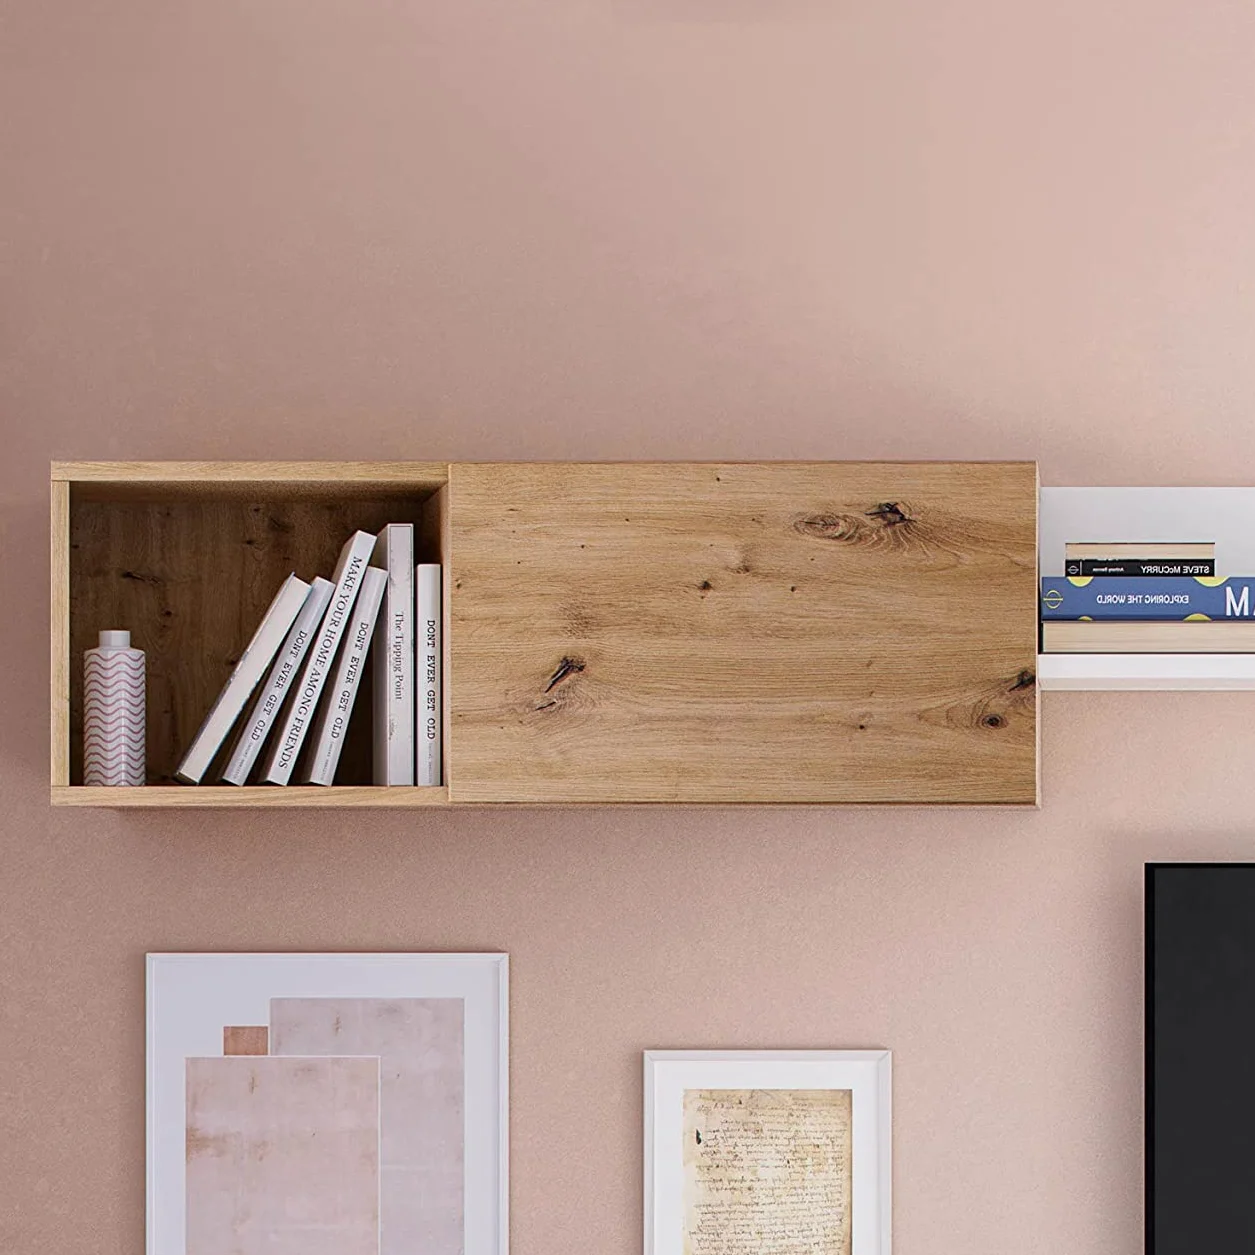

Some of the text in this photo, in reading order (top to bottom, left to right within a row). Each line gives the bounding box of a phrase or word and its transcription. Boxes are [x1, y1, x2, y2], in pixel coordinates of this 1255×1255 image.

[278, 556, 363, 769] MAKE YOUR HOME AMONG FRIENDS
[393, 612, 404, 700] The Tipping Point
[426, 620, 436, 648] DONT
[251, 630, 308, 741] DONT EVER GET OLD
[330, 622, 369, 739] DONT EVER GET OLD
[426, 655, 436, 683] EVER
[426, 690, 436, 712] GET
[426, 717, 436, 740] OLD
